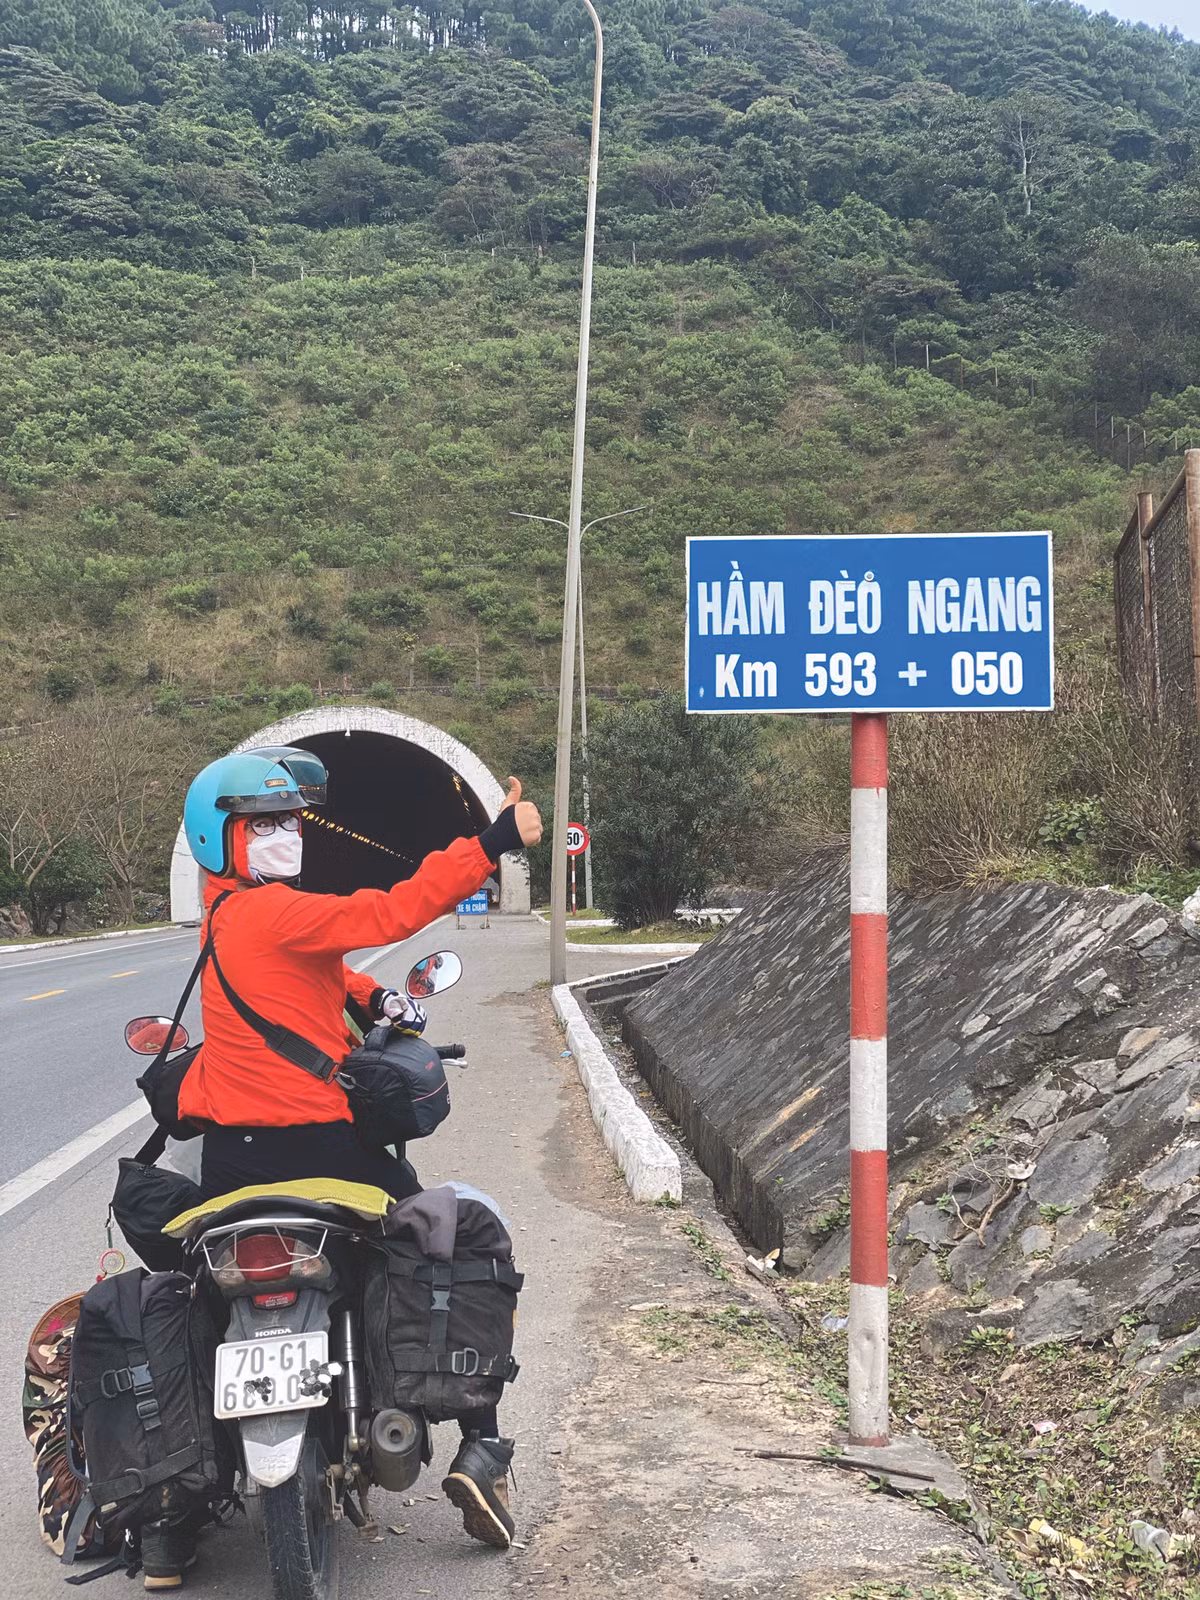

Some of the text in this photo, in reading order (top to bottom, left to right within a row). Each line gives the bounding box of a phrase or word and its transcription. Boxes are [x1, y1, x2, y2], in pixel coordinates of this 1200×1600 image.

[697, 560, 786, 635] HẦM
[908, 576, 1042, 634] NGANG
[715, 651, 1023, 698] Km 593 + 050
[567, 832, 580, 846] 50
[255, 1328, 292, 1338] HONDA
